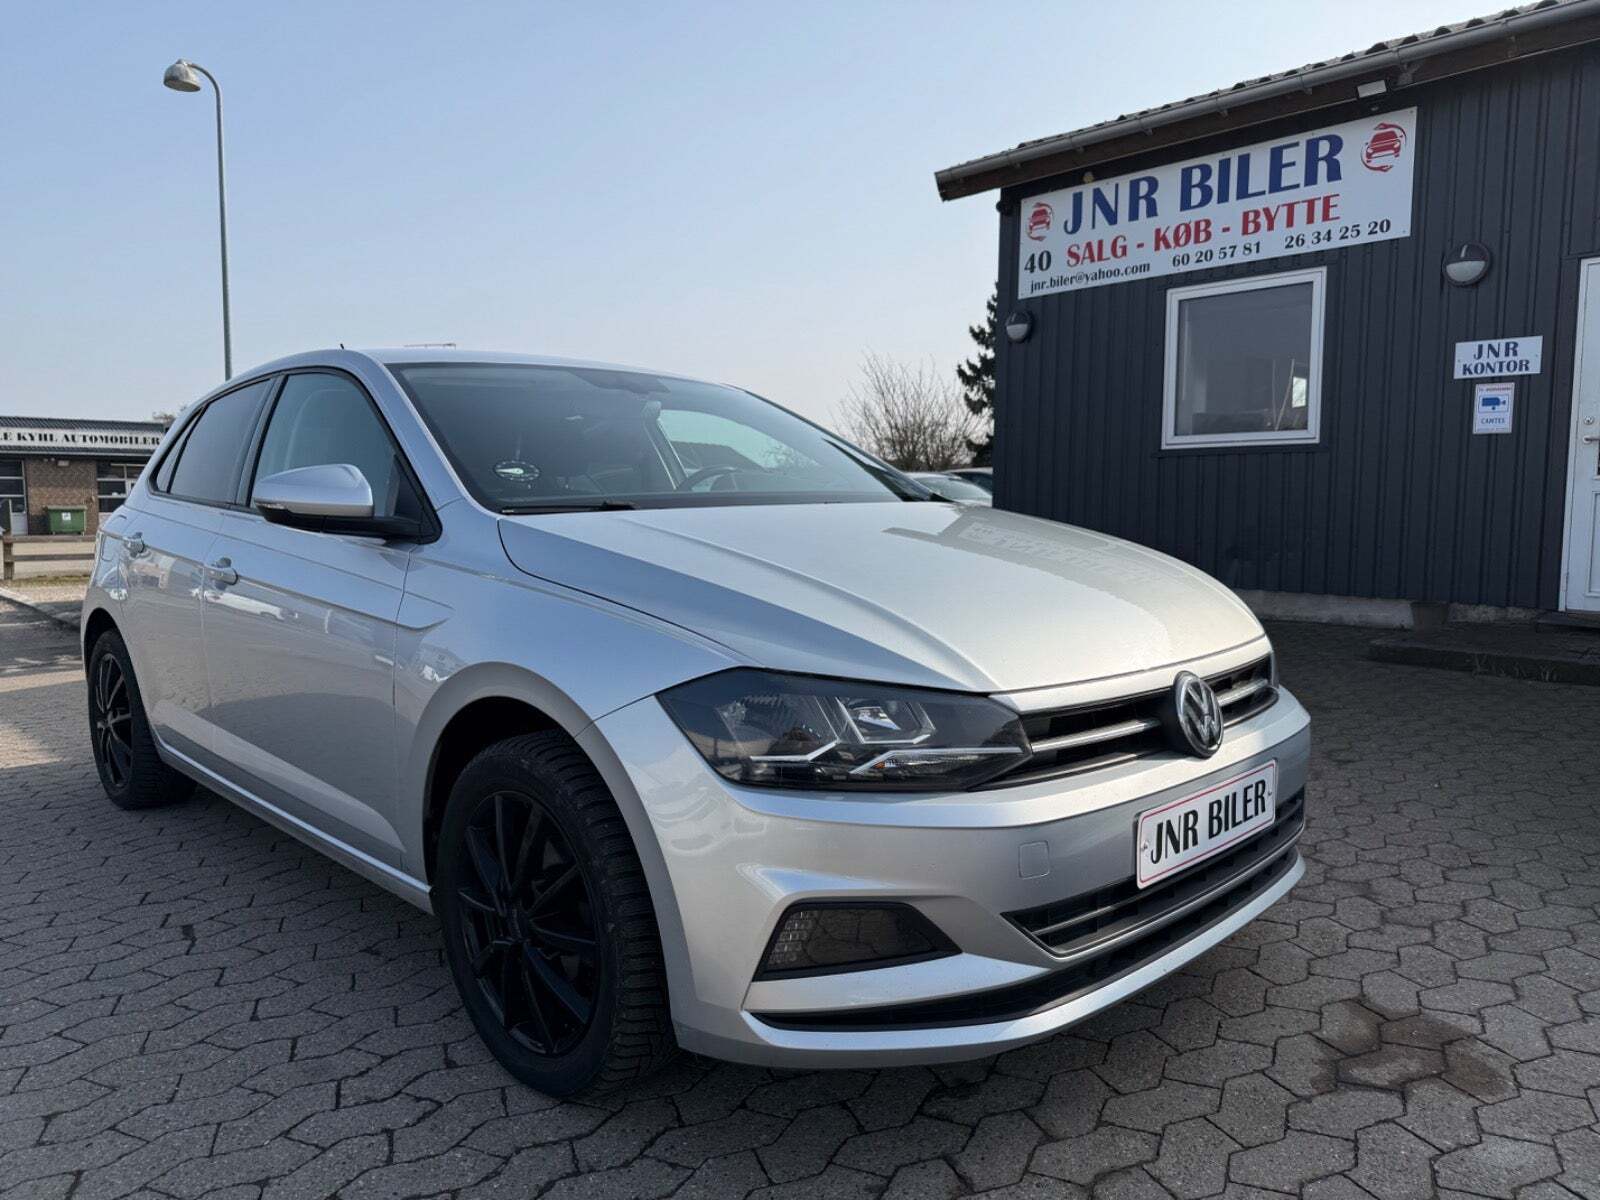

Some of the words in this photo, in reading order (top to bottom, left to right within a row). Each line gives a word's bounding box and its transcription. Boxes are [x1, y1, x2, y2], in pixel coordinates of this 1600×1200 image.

[1064, 175, 1159, 235] JNR
[1179, 133, 1344, 212] BILER
[1066, 234, 1128, 268] SALG
[1154, 217, 1212, 252] KØB
[1241, 193, 1341, 236] BYTTE
[1172, 253, 1190, 268] 60
[1195, 249, 1213, 264] 20
[1218, 244, 1237, 260] 57
[1242, 241, 1261, 257] 81
[1284, 232, 1306, 249] 26
[1311, 228, 1332, 245] 34
[1339, 223, 1361, 240] 25
[1367, 218, 1391, 236] 20
[1024, 250, 1052, 274] 40
[1030, 262, 1151, 293] jnr.biler@yahoo.com
[1473, 341, 1519, 360] JNR
[1462, 359, 1530, 376] KONTOR
[62, 433, 160, 446] AUTOMOBILER
[1150, 808, 1200, 865] JNR
[1207, 778, 1267, 840] BILER
